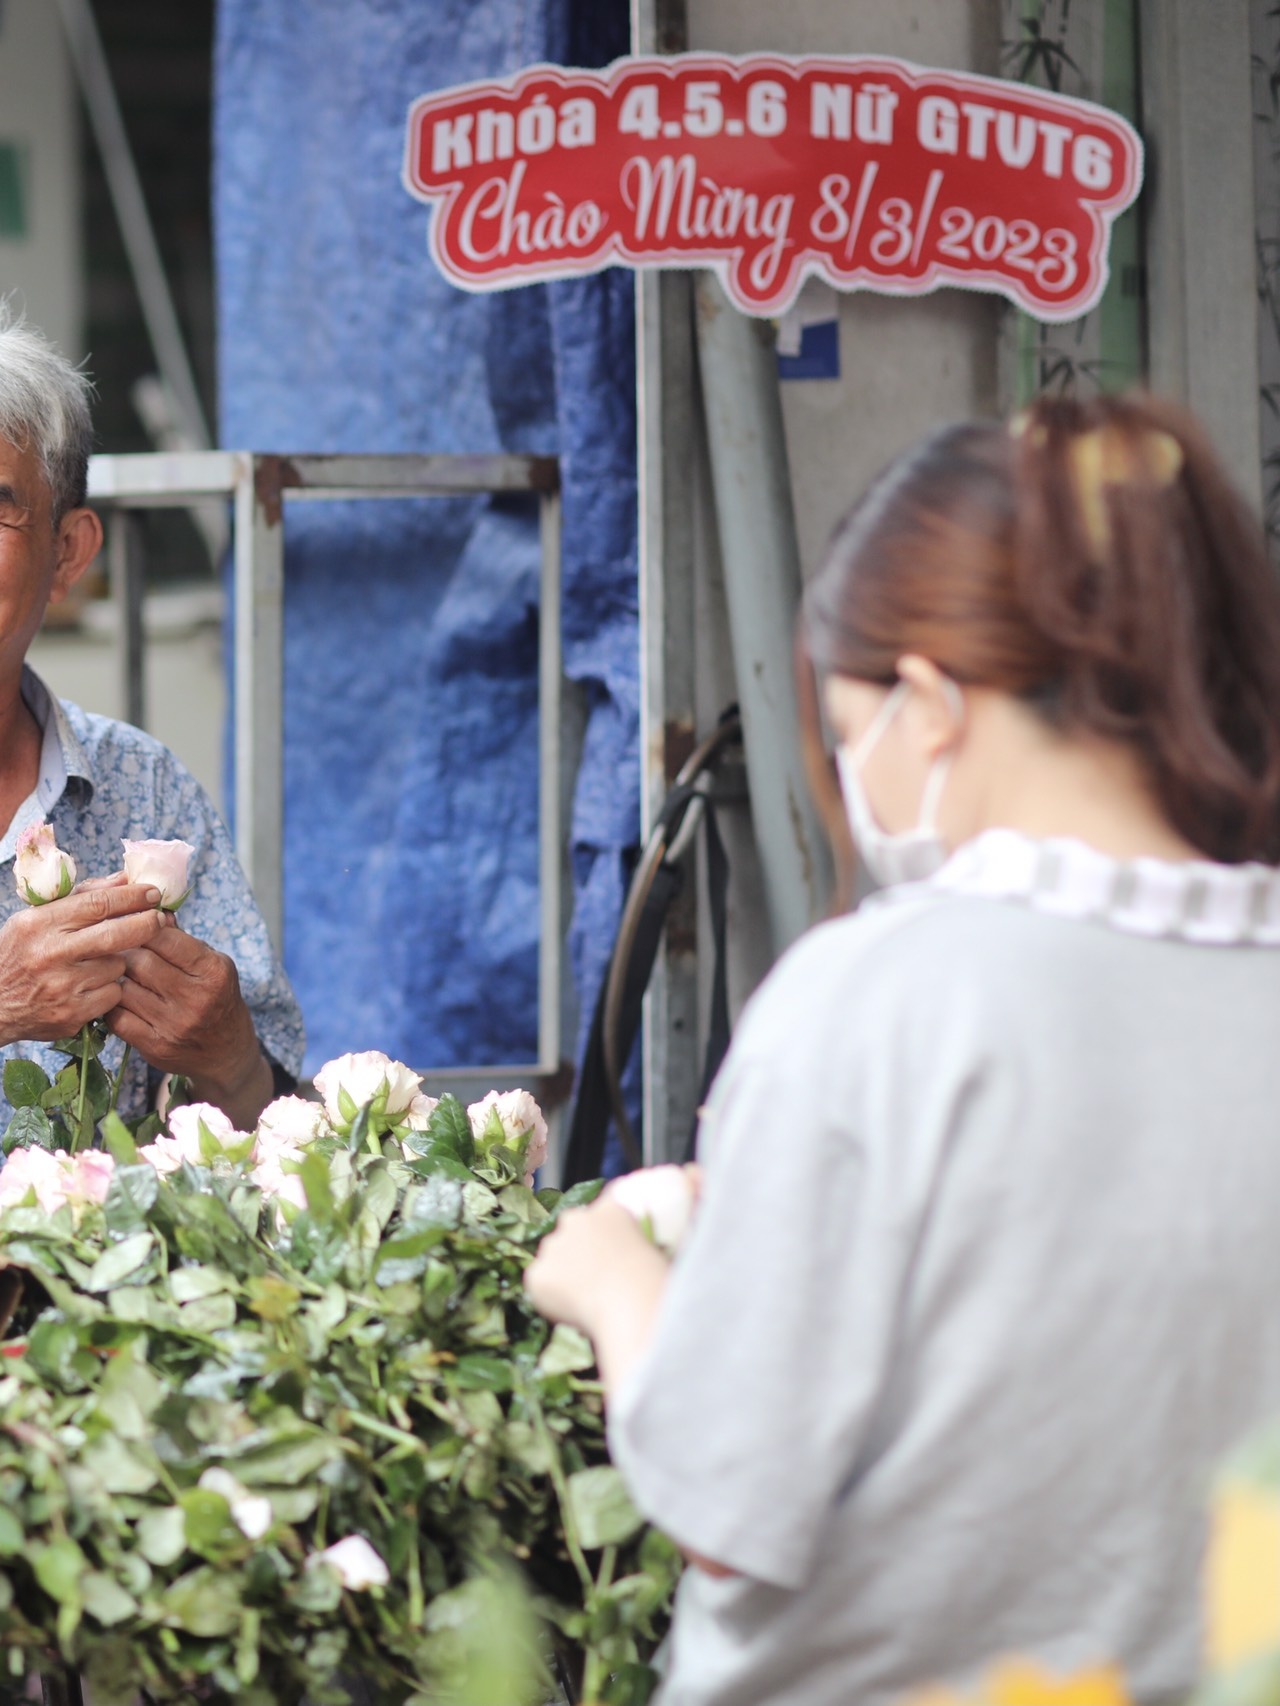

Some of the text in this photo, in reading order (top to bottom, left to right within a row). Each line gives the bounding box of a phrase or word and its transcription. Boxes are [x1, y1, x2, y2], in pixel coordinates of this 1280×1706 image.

[432, 94, 596, 174] Khóa
[618, 80, 787, 139] 4.5.6
[810, 82, 899, 145] Nữ
[458, 153, 1078, 293] Chào Mừng 8/3/2023
